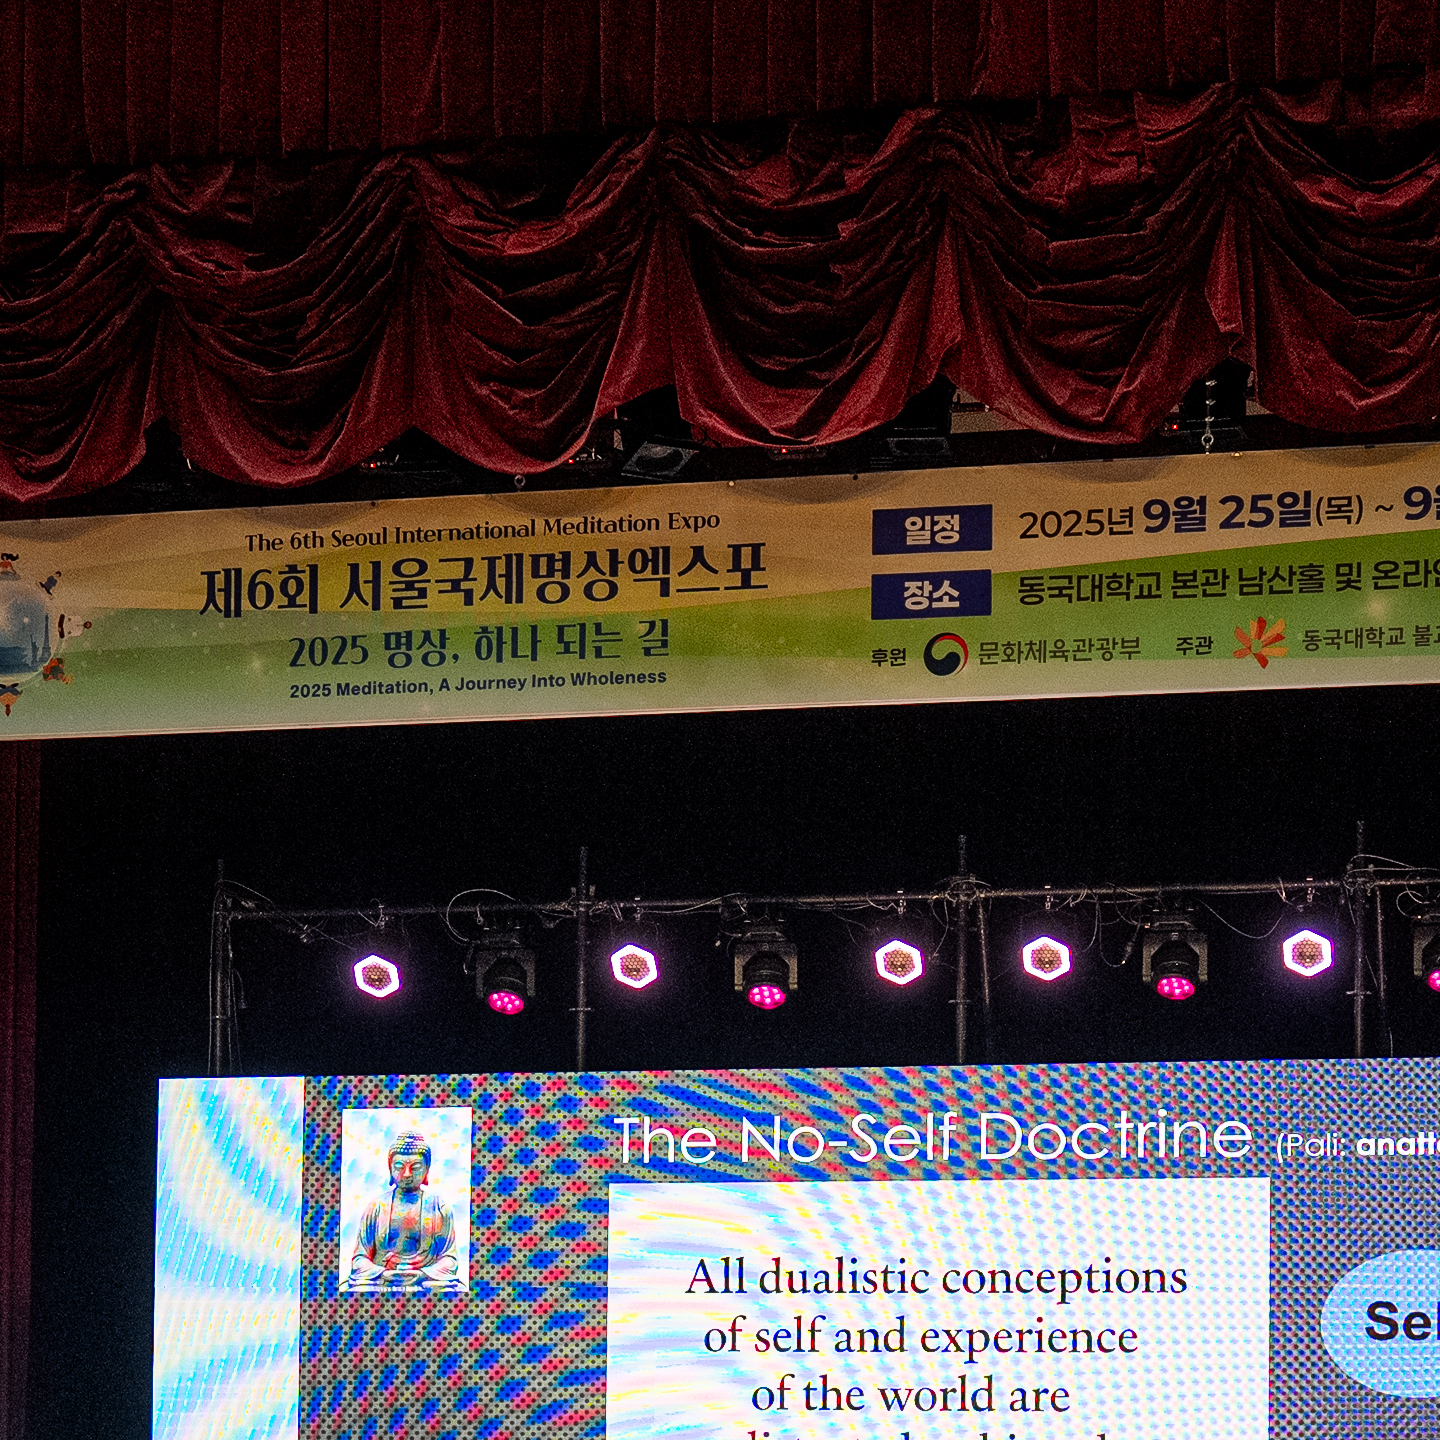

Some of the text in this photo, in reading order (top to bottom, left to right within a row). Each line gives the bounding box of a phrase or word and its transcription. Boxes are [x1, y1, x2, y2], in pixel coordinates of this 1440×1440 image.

[245, 512, 720, 551] The 6th Seoul International Meditation Expo
[904, 514, 960, 546] 일정
[1019, 506, 1134, 539] 2025년
[1142, 495, 1207, 534] 9월
[1218, 489, 1364, 530] 25일(목)
[199, 542, 768, 618] 제6회 서울국제명상엑스포
[903, 579, 960, 611] 장소
[1018, 571, 1162, 606] 동국대학교
[1171, 567, 1229, 600] 본관
[1238, 563, 1326, 597] 남산홀
[1335, 561, 1362, 593] 및
[289, 618, 669, 668] 2025 명상, 하나 되는 길
[871, 637, 1141, 668] 후원 문화체육관광부
[1176, 636, 1213, 656] 주관
[1302, 627, 1406, 652] 동국대학교
[290, 670, 667, 698] 2025 Meditation, A Journey Into Wholeness
[613, 1114, 718, 1164] The
[741, 1111, 957, 1163] No-Self
[980, 1108, 1252, 1161] Doctrine
[685, 1256, 1188, 1305] All dualistic conceptions
[704, 1315, 1138, 1364] of self and experience
[751, 1373, 1071, 1413] of the world are
